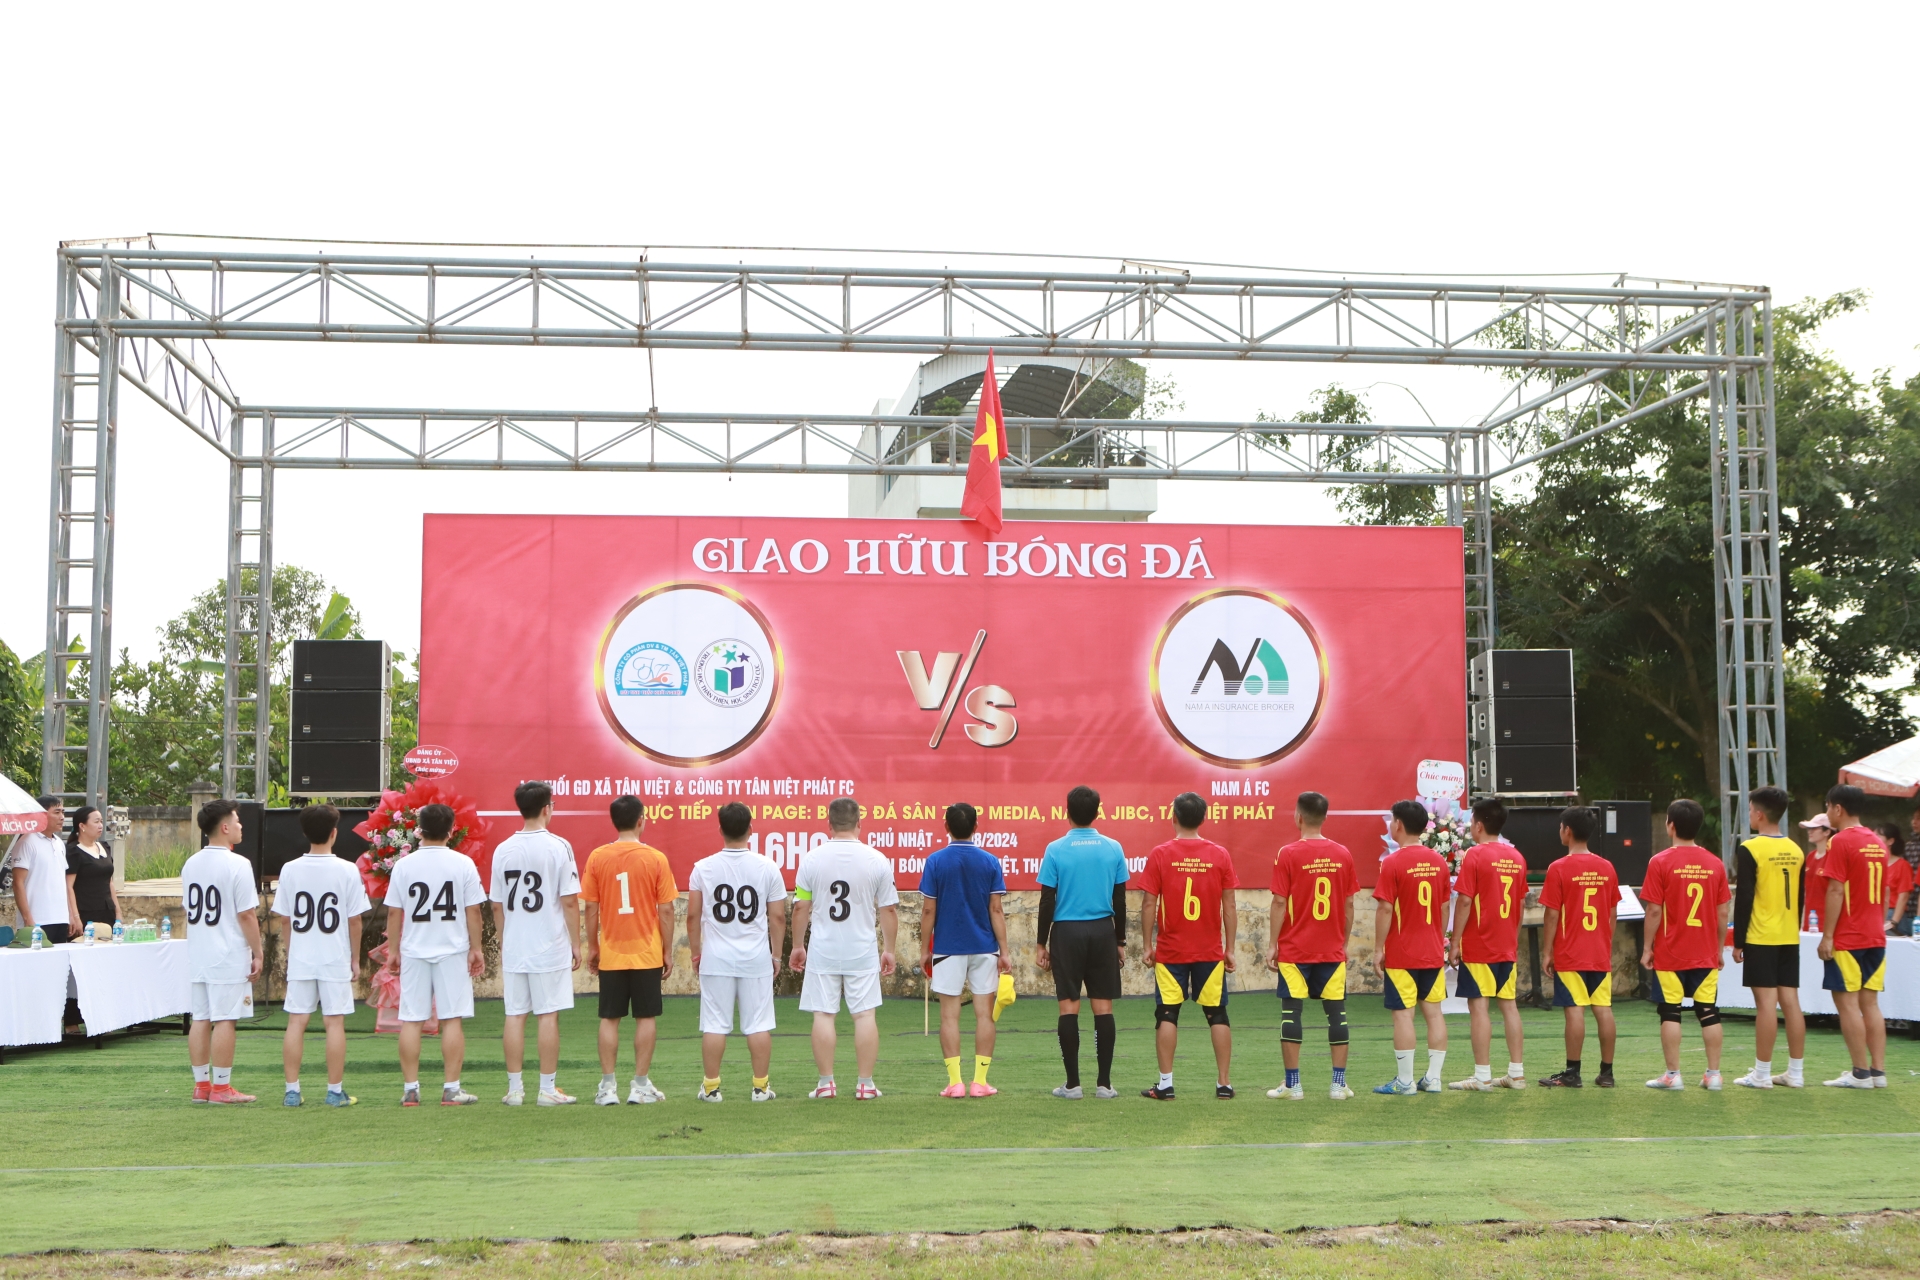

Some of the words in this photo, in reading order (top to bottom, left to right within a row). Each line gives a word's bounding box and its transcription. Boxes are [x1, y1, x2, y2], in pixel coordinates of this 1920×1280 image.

[692, 538, 829, 574] GIAO
[844, 533, 969, 576] HỮU
[983, 535, 1127, 577] BÓNG
[1141, 537, 1214, 578] ĐÁ
[1185, 703, 1204, 711] NAM
[1204, 703, 1210, 711] A
[1212, 703, 1258, 711] INSURANCE
[1260, 703, 1295, 711] BROKER
[574, 780, 591, 796] GD
[594, 777, 612, 796] XÃ
[615, 777, 642, 796] TÂN
[644, 777, 670, 798] VIỆT
[674, 780, 684, 796] &
[688, 777, 723, 796] CÔNG
[727, 780, 742, 796] TY
[745, 777, 772, 796] TÂN
[773, 777, 800, 798] VIỆT
[804, 777, 836, 796] PHÁT
[839, 780, 854, 796] FC
[1212, 780, 1238, 796] NAM
[1243, 778, 1252, 796] Á
[1254, 780, 1270, 796] FC
[1420, 770, 1439, 780] Chúc
[1, 819, 22, 832] XÍCH
[24, 820, 38, 830] CP
[678, 799, 712, 820] TIẾP
[762, 806, 811, 820] PAGE:
[873, 802, 898, 820] ĐÁ
[902, 802, 936, 820] SÂN
[988, 806, 1046, 822] MEDIA,
[1234, 802, 1275, 820] PHÁT
[868, 827, 894, 848] CHỦ
[898, 829, 933, 850] NHẬT
[188, 882, 222, 926] 99
[408, 881, 458, 922] 24
[504, 870, 544, 913] 73
[616, 872, 634, 914] 1
[712, 884, 759, 924] 89
[829, 880, 851, 922] 3
[1184, 876, 1200, 921] 6
[1313, 876, 1331, 920] 8
[1418, 880, 1432, 925] 9
[1500, 875, 1513, 919] 3
[1782, 868, 1791, 910] 1
[1868, 862, 1882, 904] 11
[292, 891, 340, 934] 96
[1582, 888, 1598, 931] 5
[1686, 882, 1704, 927] 2
